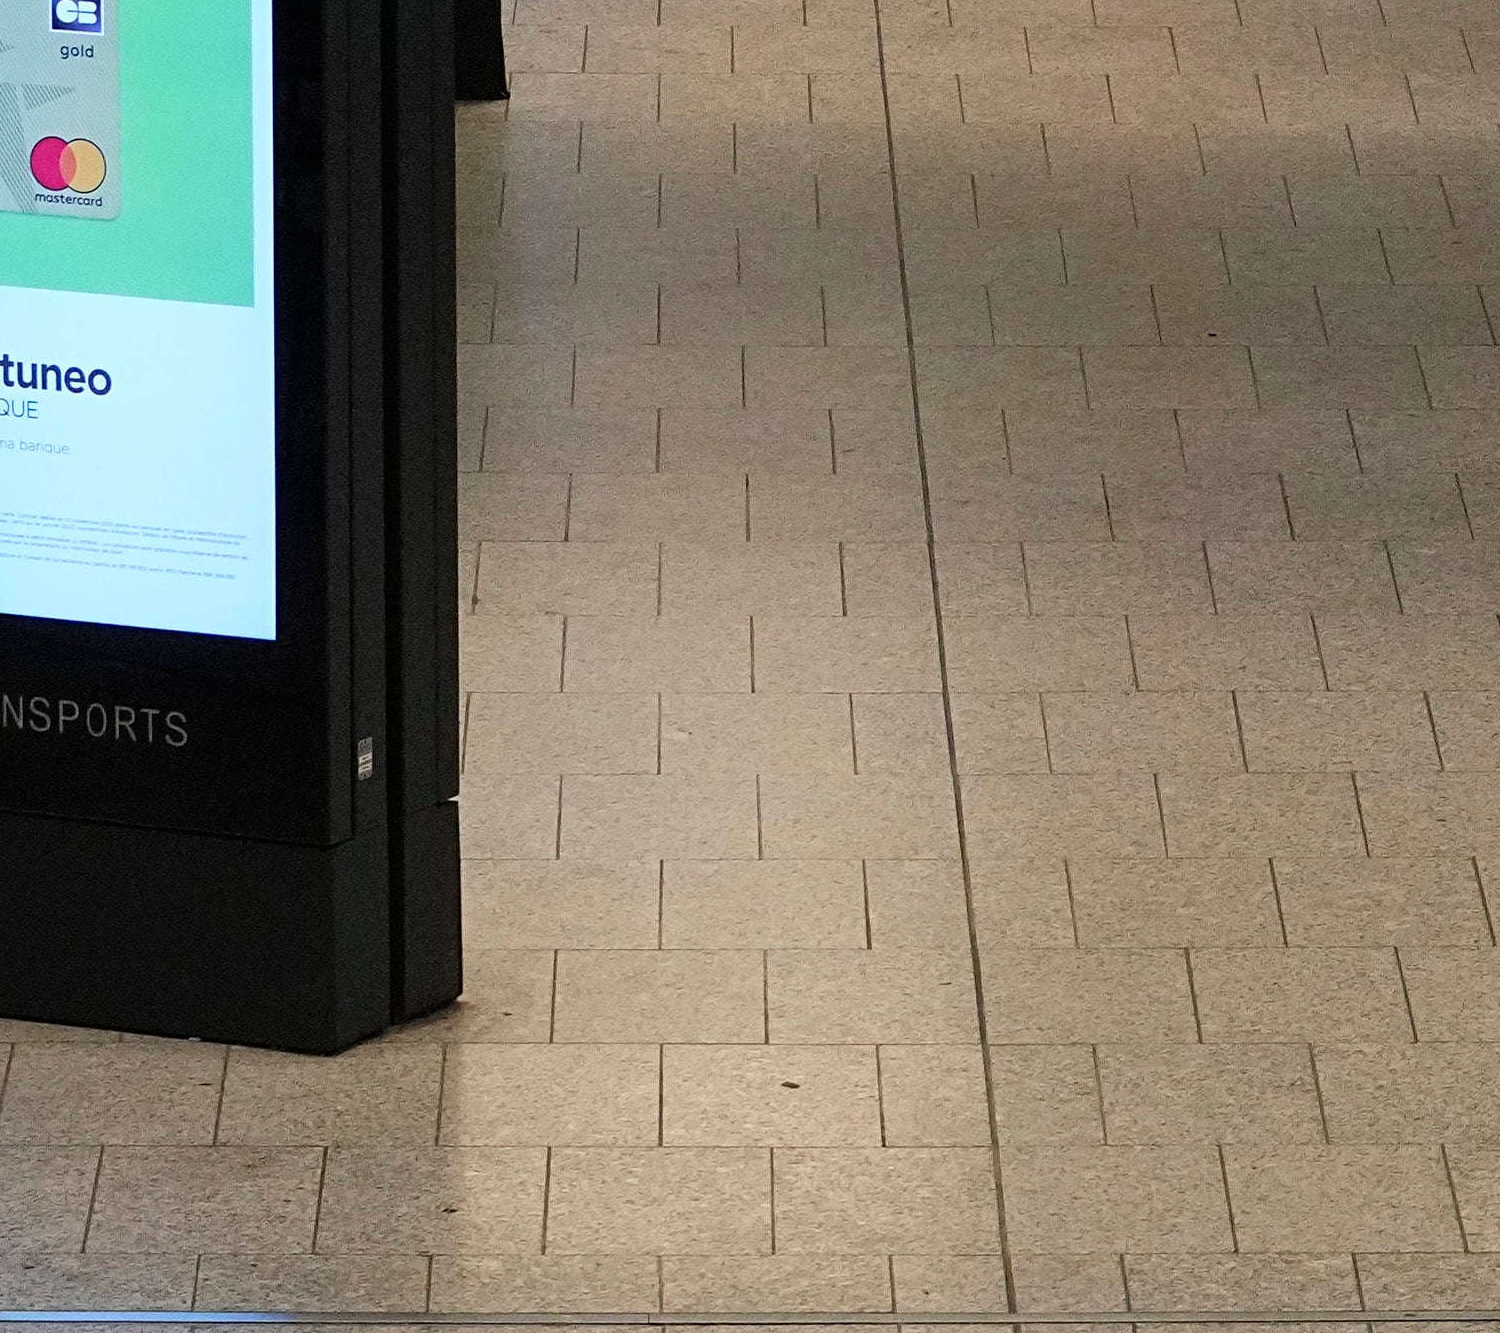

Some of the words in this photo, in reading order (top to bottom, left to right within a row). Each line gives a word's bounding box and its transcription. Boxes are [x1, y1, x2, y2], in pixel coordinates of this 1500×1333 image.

[60, 43, 95, 60] gold
[35, 192, 104, 208] mastercard
[19, 439, 70, 455] banque
